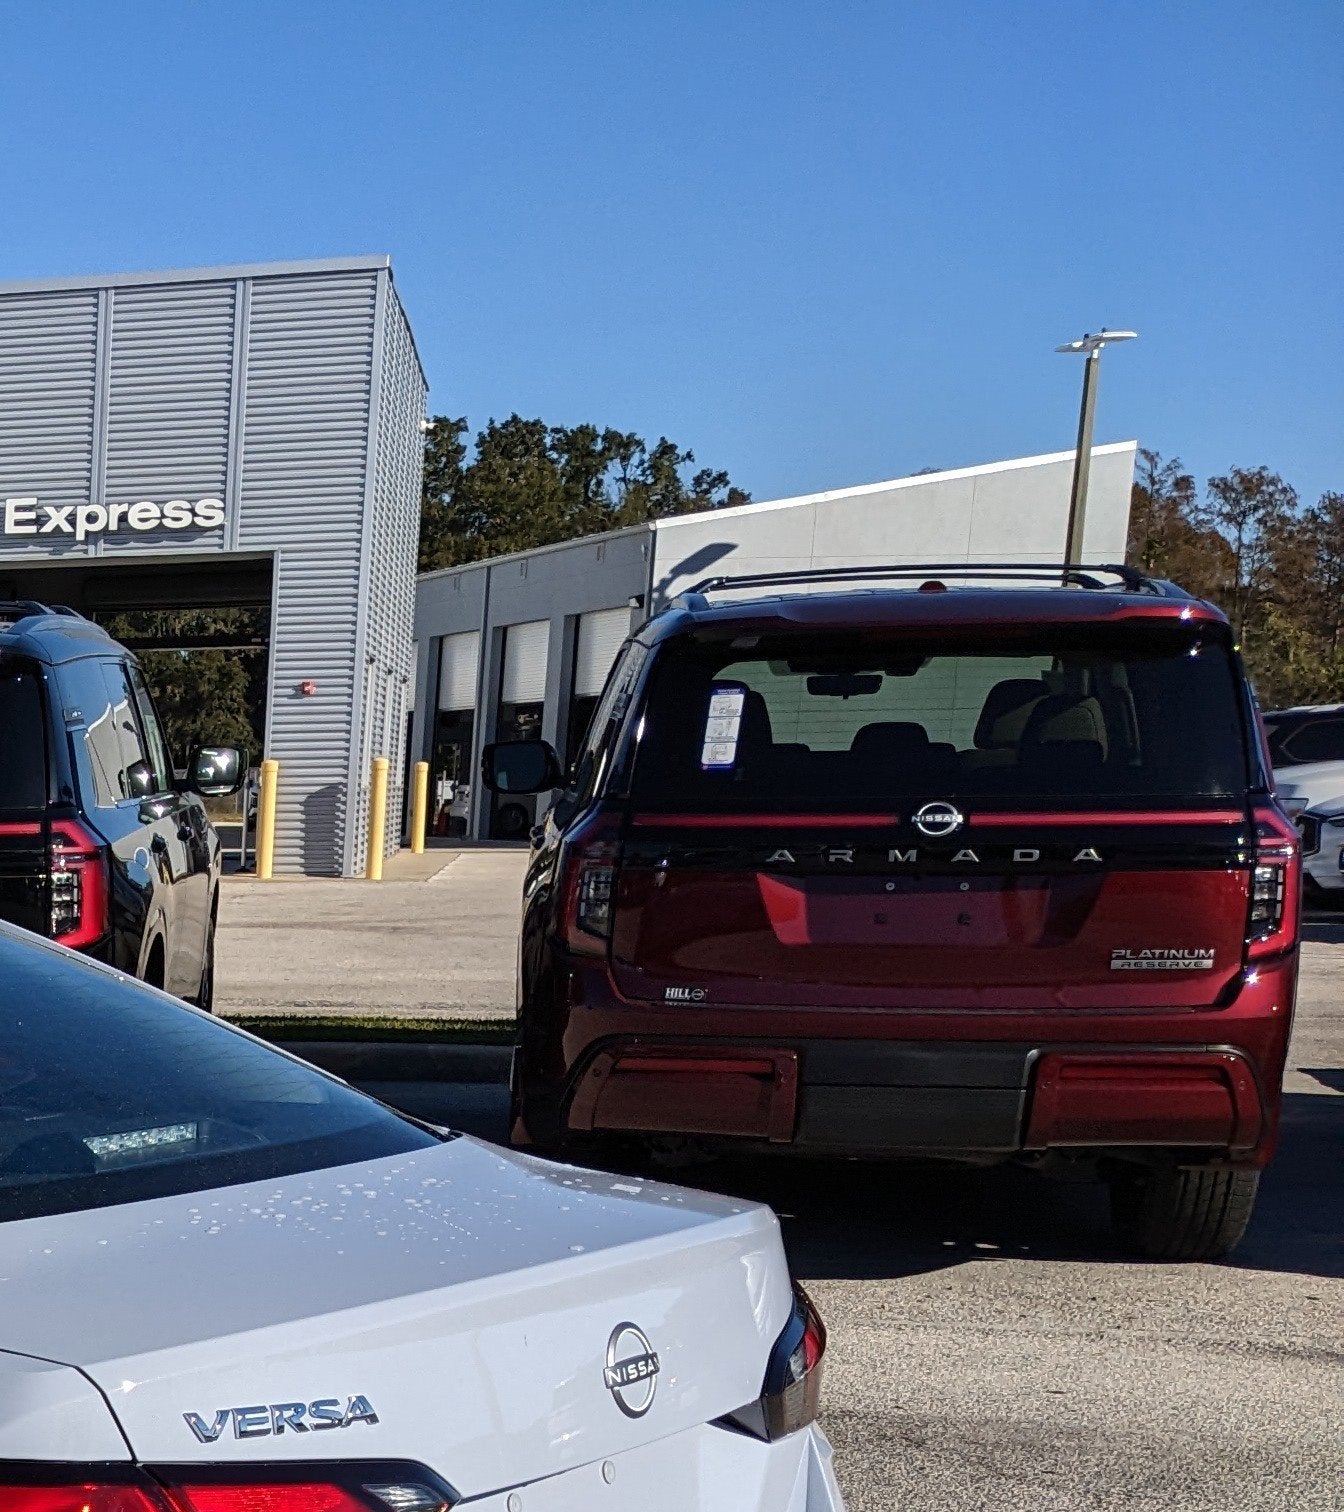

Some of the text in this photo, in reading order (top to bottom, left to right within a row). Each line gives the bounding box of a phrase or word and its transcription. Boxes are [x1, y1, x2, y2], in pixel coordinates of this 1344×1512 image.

[4, 497, 225, 541] Express
[912, 814, 964, 823] NISSAN
[765, 848, 1103, 863] ARMADA
[1112, 948, 1216, 959] PLATINUM
[1120, 960, 1204, 968] RESERVE
[664, 987, 691, 1000] HILL
[182, 1394, 380, 1444] VERSA
